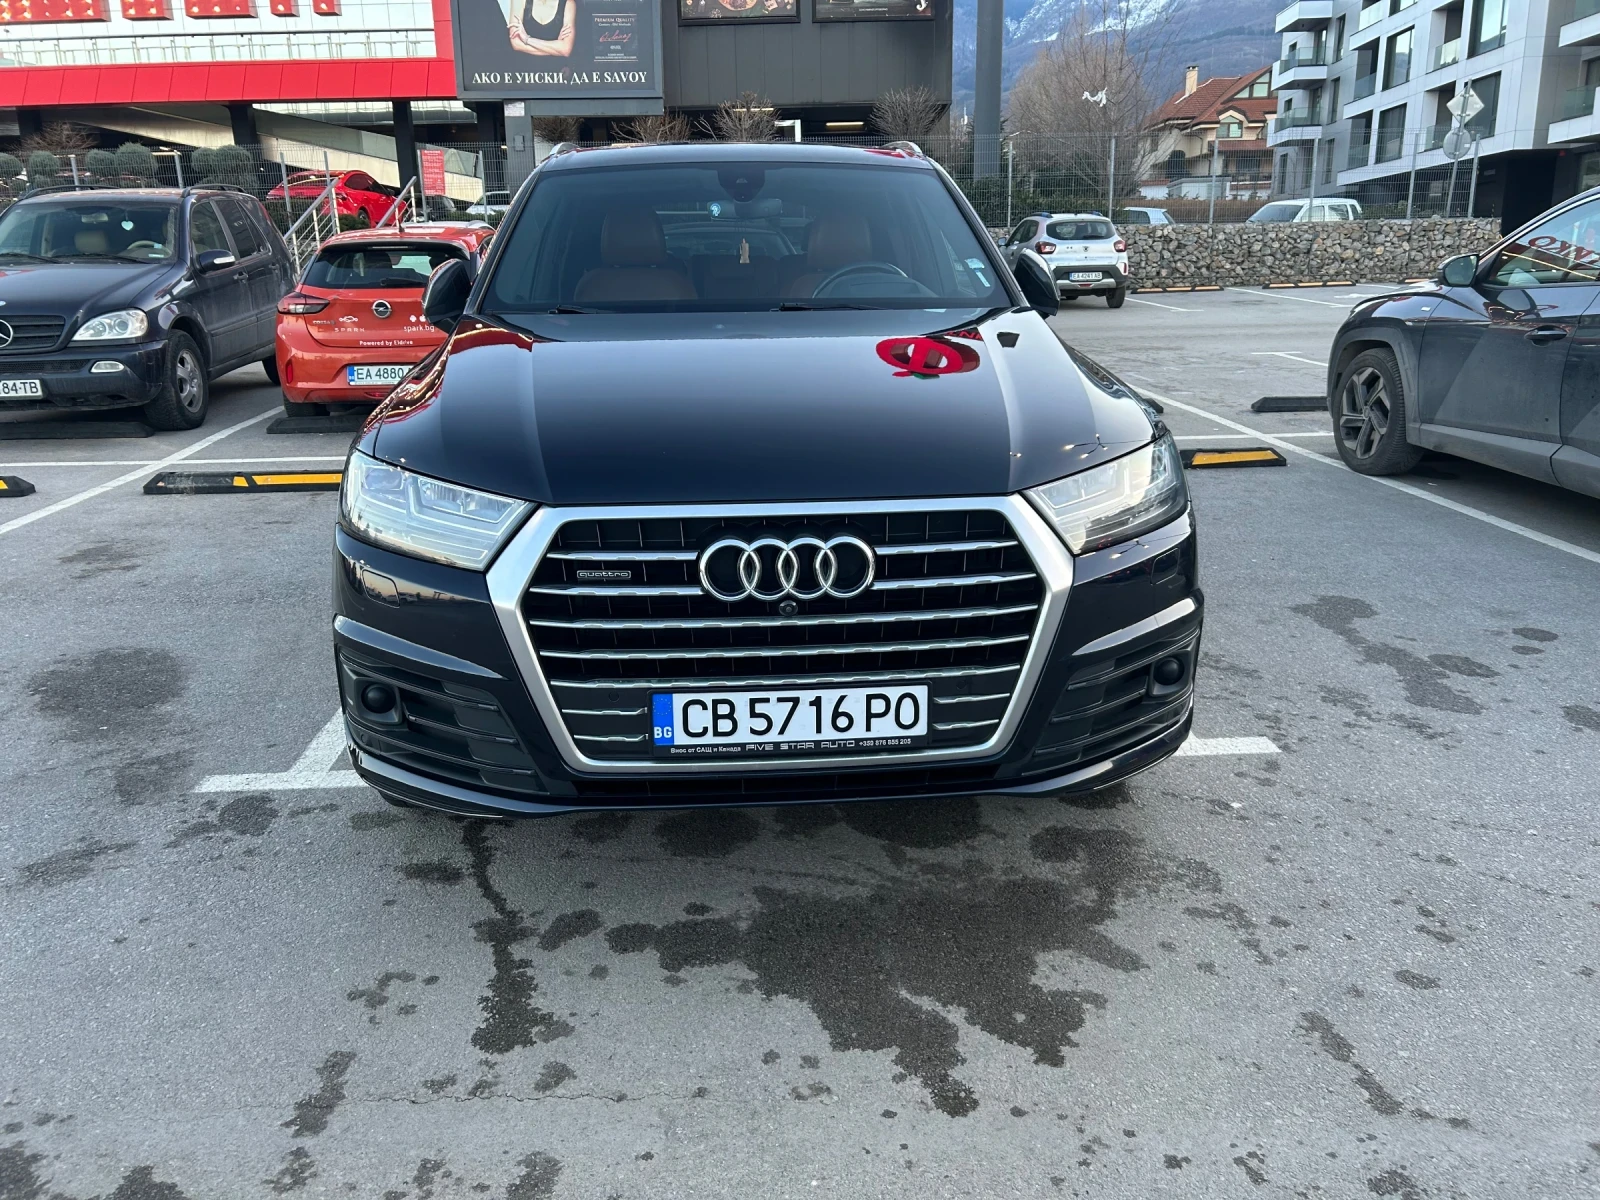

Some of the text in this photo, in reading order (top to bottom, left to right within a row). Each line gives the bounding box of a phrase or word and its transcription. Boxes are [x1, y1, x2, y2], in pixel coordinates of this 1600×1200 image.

[472, 71, 647, 85] АКО Е УИСКИ, ДА Е SAVOY
[404, 324, 435, 333] spark.bg
[356, 367, 405, 380] EA 4880
[653, 726, 673, 739] BG
[780, 742, 815, 750] STAR
[820, 740, 855, 749] AUTO
